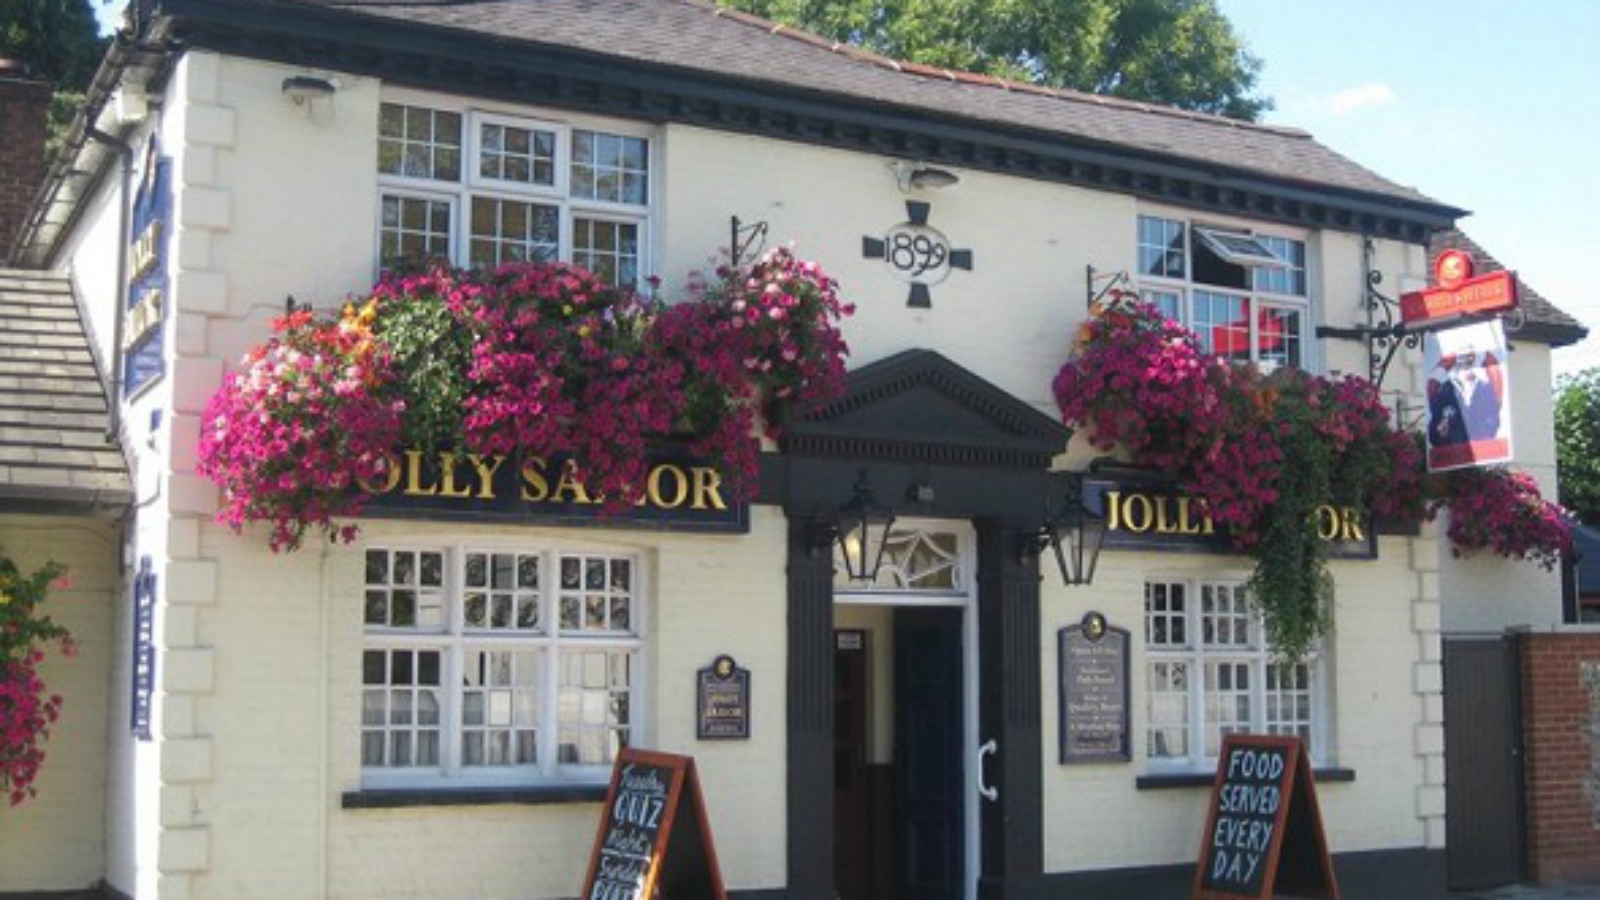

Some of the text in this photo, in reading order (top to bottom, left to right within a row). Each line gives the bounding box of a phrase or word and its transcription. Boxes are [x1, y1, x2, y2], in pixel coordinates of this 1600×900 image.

[885, 232, 947, 276] 1899
[357, 450, 726, 510] OLLY SAOR
[1228, 750, 1284, 780] FOOD
[1219, 784, 1281, 814] SERVED
[1213, 817, 1274, 852] EVERY
[1212, 851, 1260, 884] DAY
